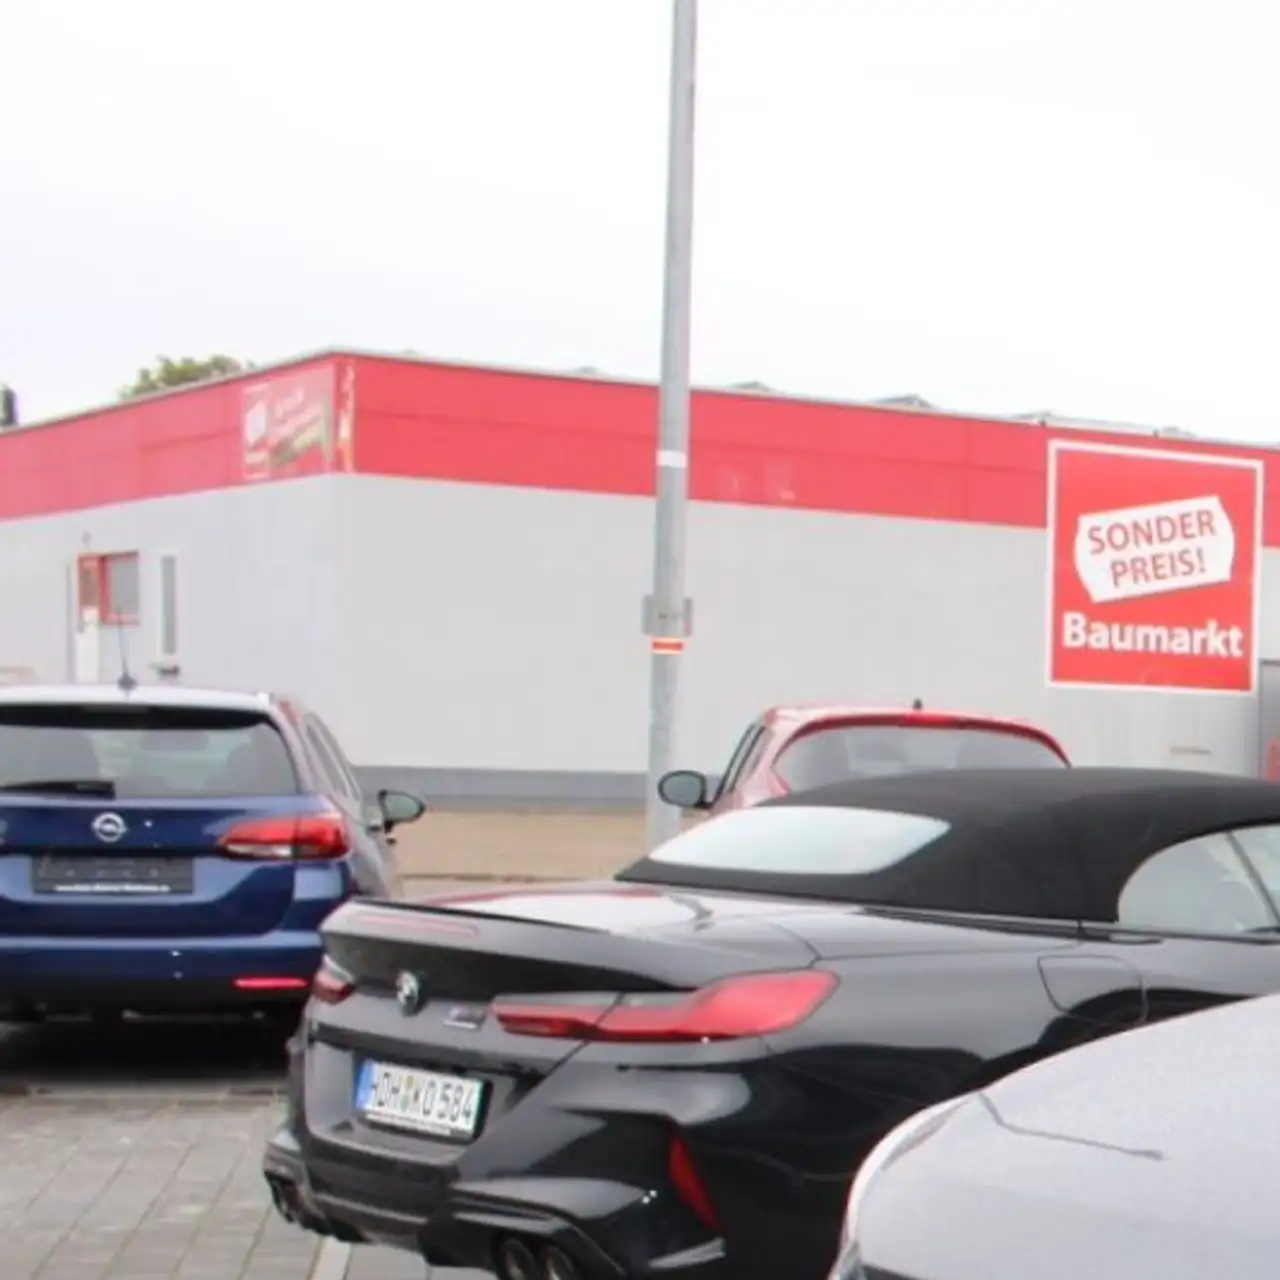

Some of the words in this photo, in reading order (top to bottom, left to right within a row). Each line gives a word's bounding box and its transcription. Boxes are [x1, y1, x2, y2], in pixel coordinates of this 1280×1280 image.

[1088, 508, 1217, 555] SONDER
[1110, 547, 1207, 587] PREIS!
[1062, 611, 1244, 658] Baumarkt
